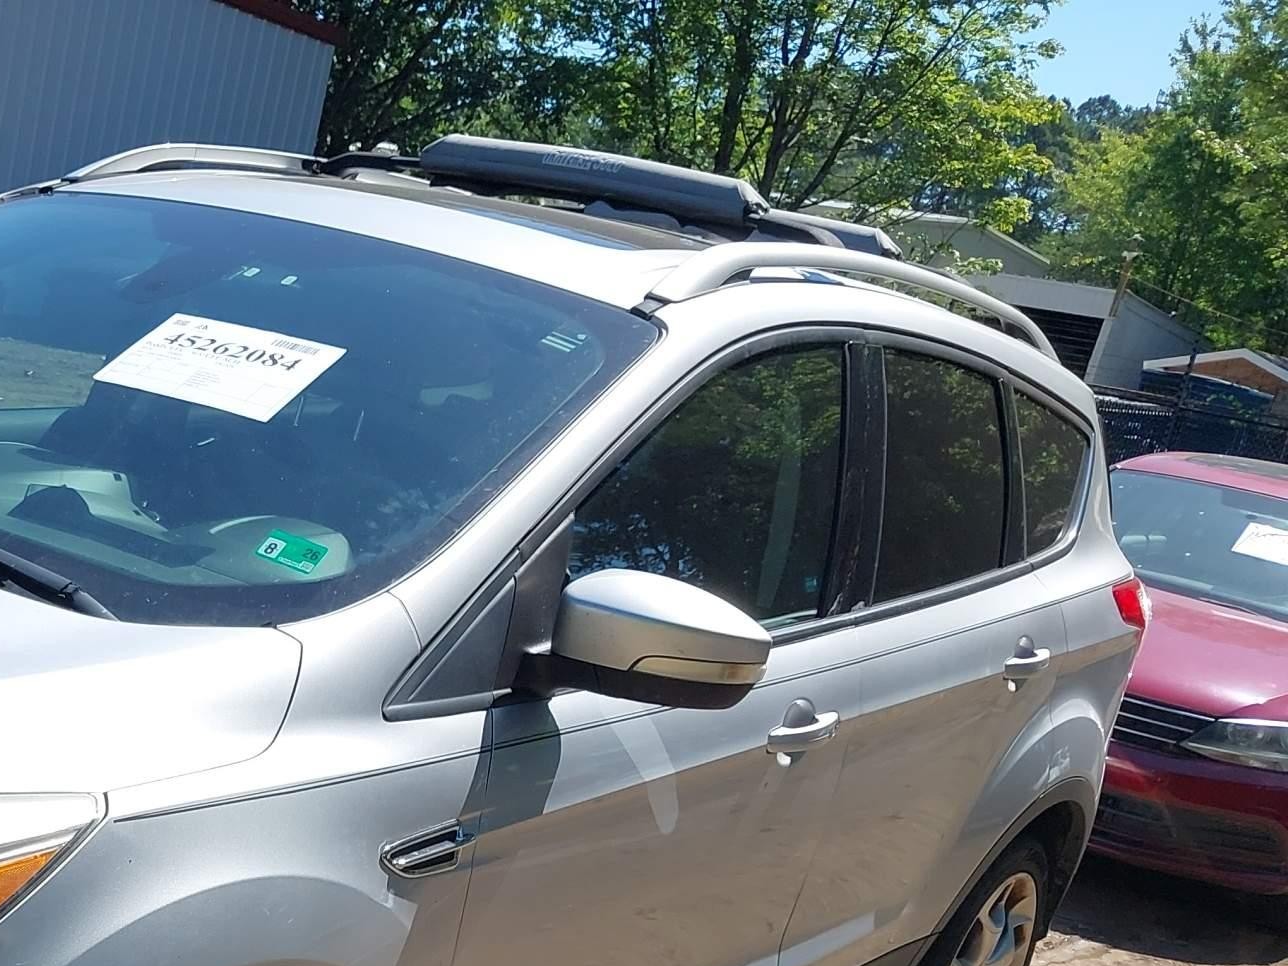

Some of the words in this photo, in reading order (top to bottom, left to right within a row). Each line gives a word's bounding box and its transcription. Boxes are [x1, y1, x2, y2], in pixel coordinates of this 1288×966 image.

[164, 332, 302, 371] 45262084
[263, 542, 278, 555] 8
[302, 548, 321, 561] 26
